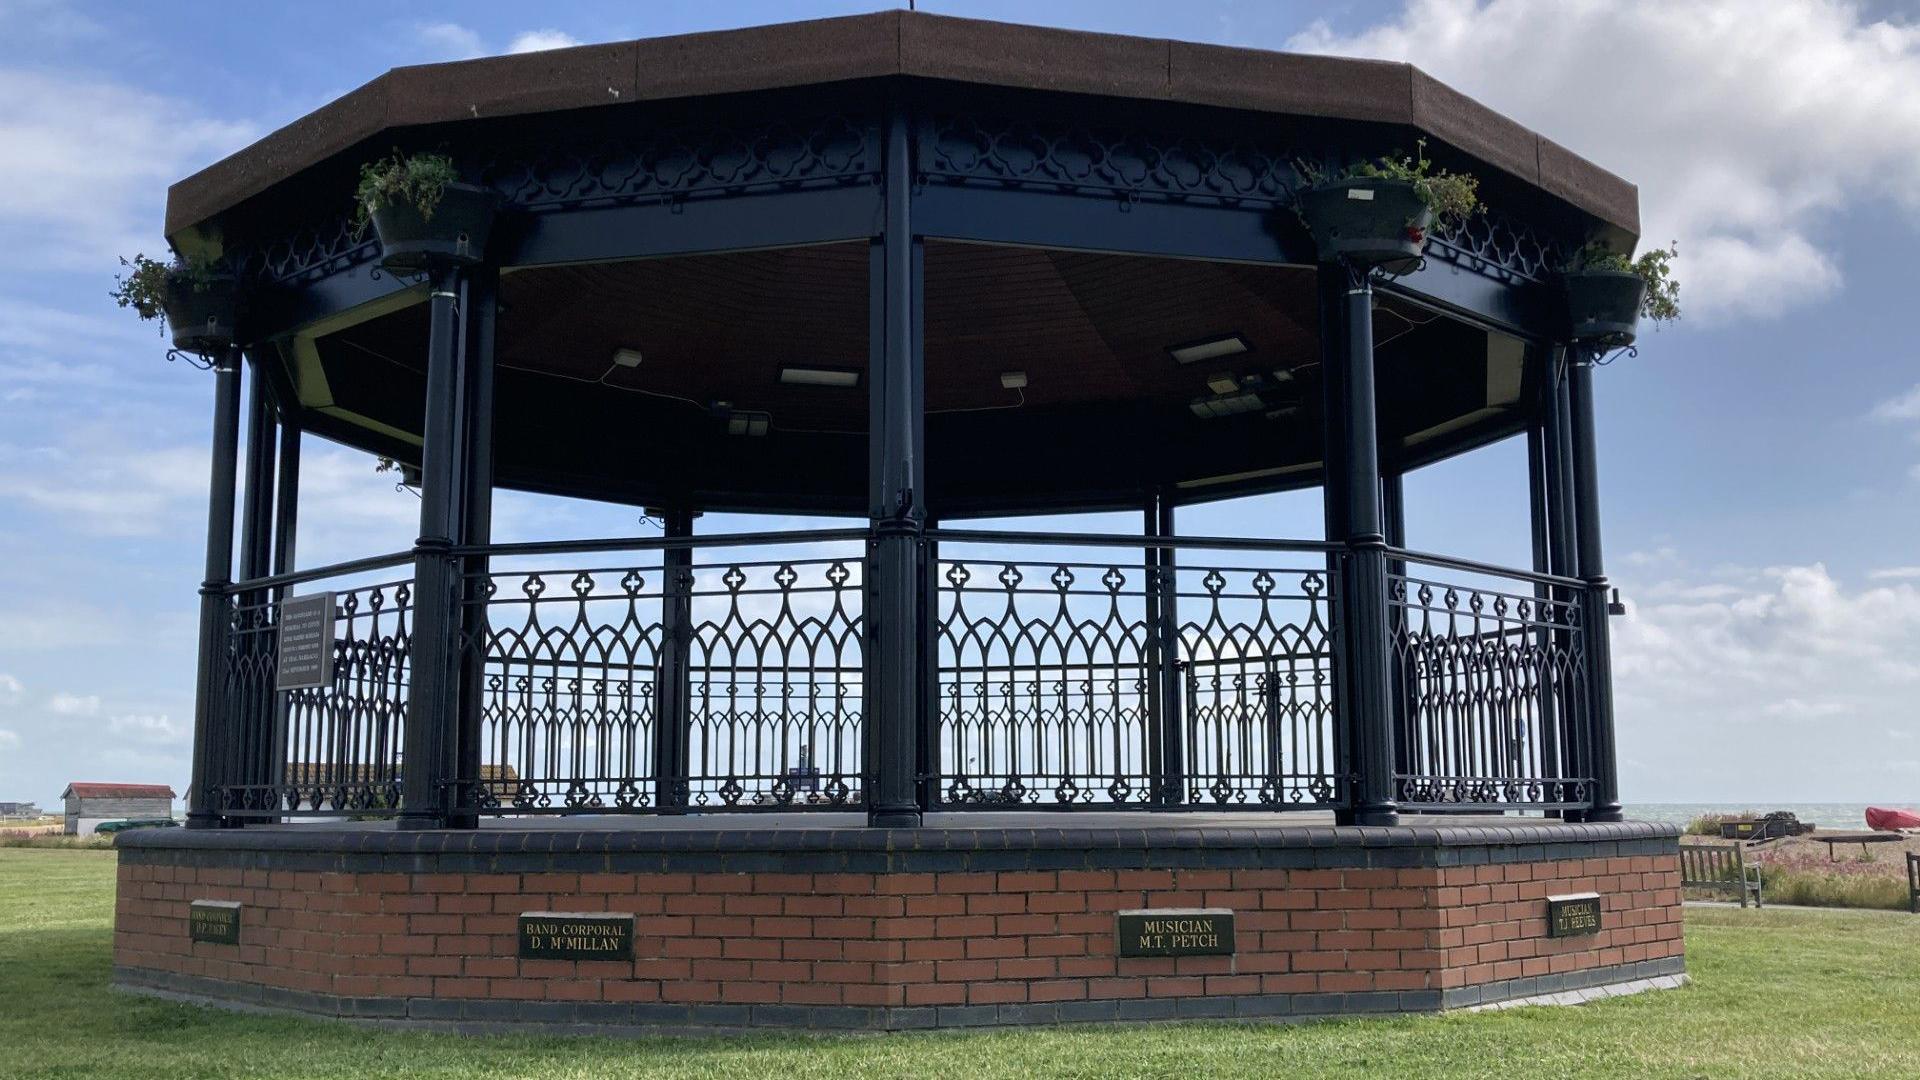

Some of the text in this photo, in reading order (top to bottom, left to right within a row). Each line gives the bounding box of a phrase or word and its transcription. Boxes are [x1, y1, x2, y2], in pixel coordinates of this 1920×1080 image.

[1561, 903, 1593, 917] MUSICIAN
[526, 923, 625, 936] BAND CORPORAL
[1144, 920, 1213, 934] MUSICIAN
[531, 937, 545, 949] D.
[1140, 934, 1219, 949] M.T. PETCH
